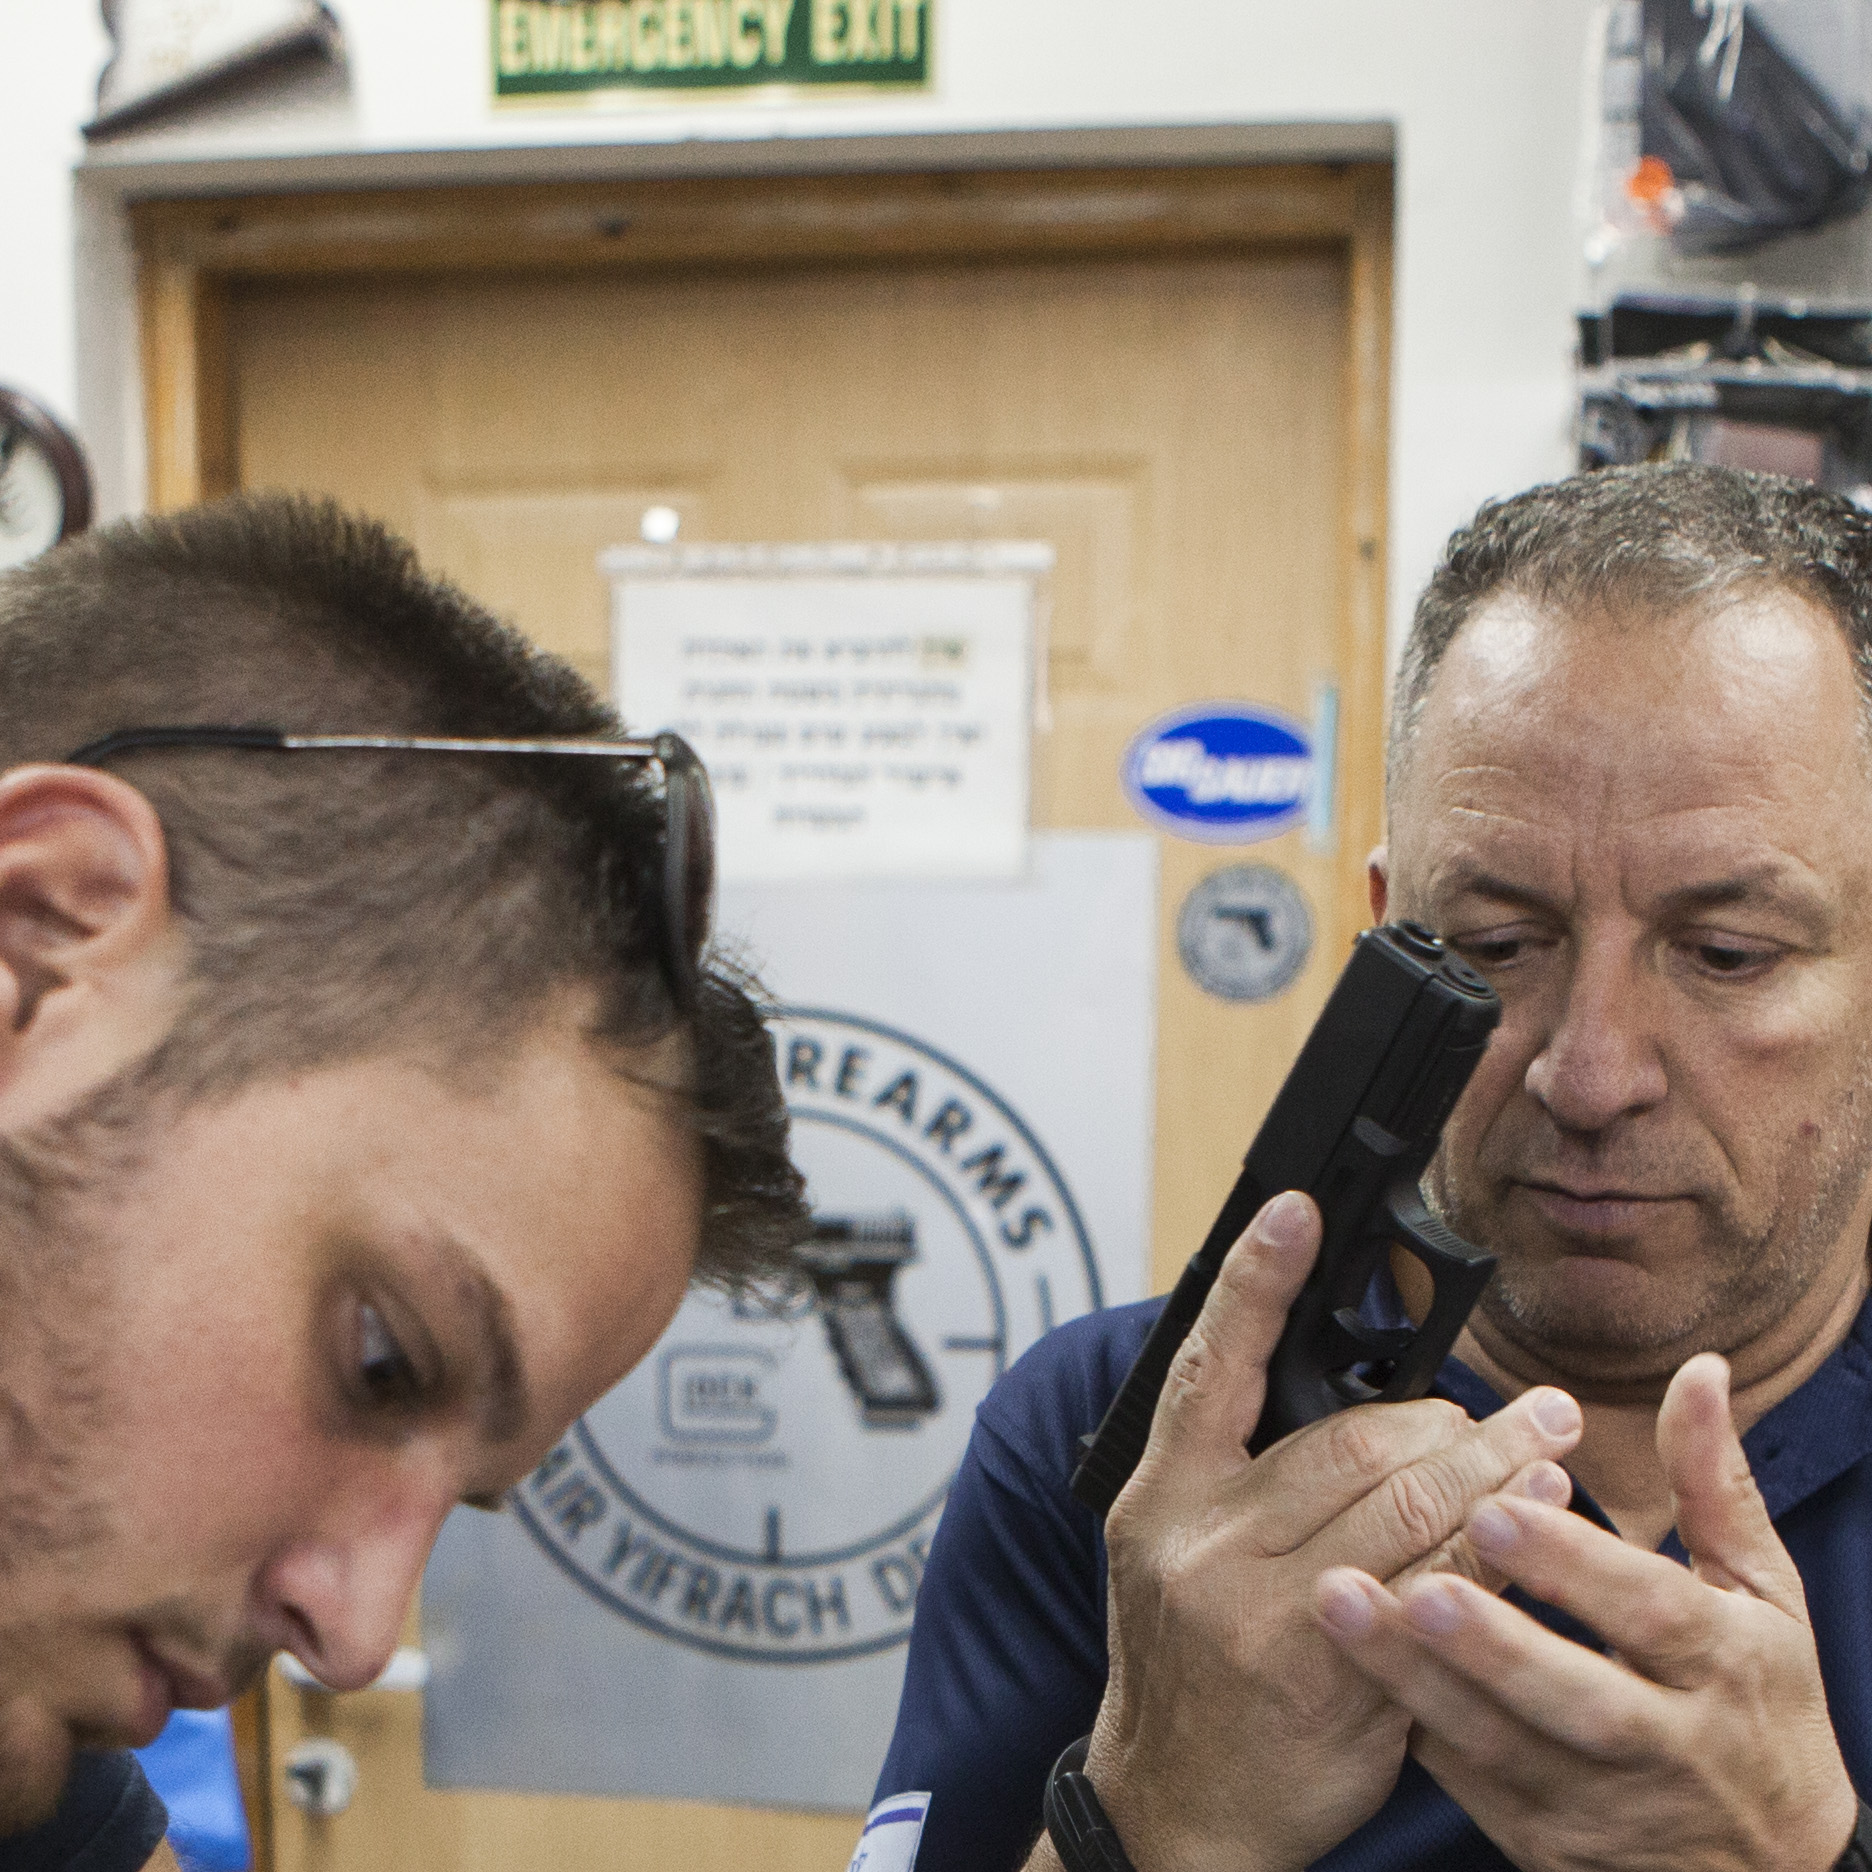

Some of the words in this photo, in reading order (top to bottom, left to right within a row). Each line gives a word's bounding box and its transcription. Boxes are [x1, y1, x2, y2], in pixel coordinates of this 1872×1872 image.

[499, 0, 788, 75] EMERGENCY
[812, 0, 921, 65] EXIT
[783, 1035, 1057, 1251] REARMS
